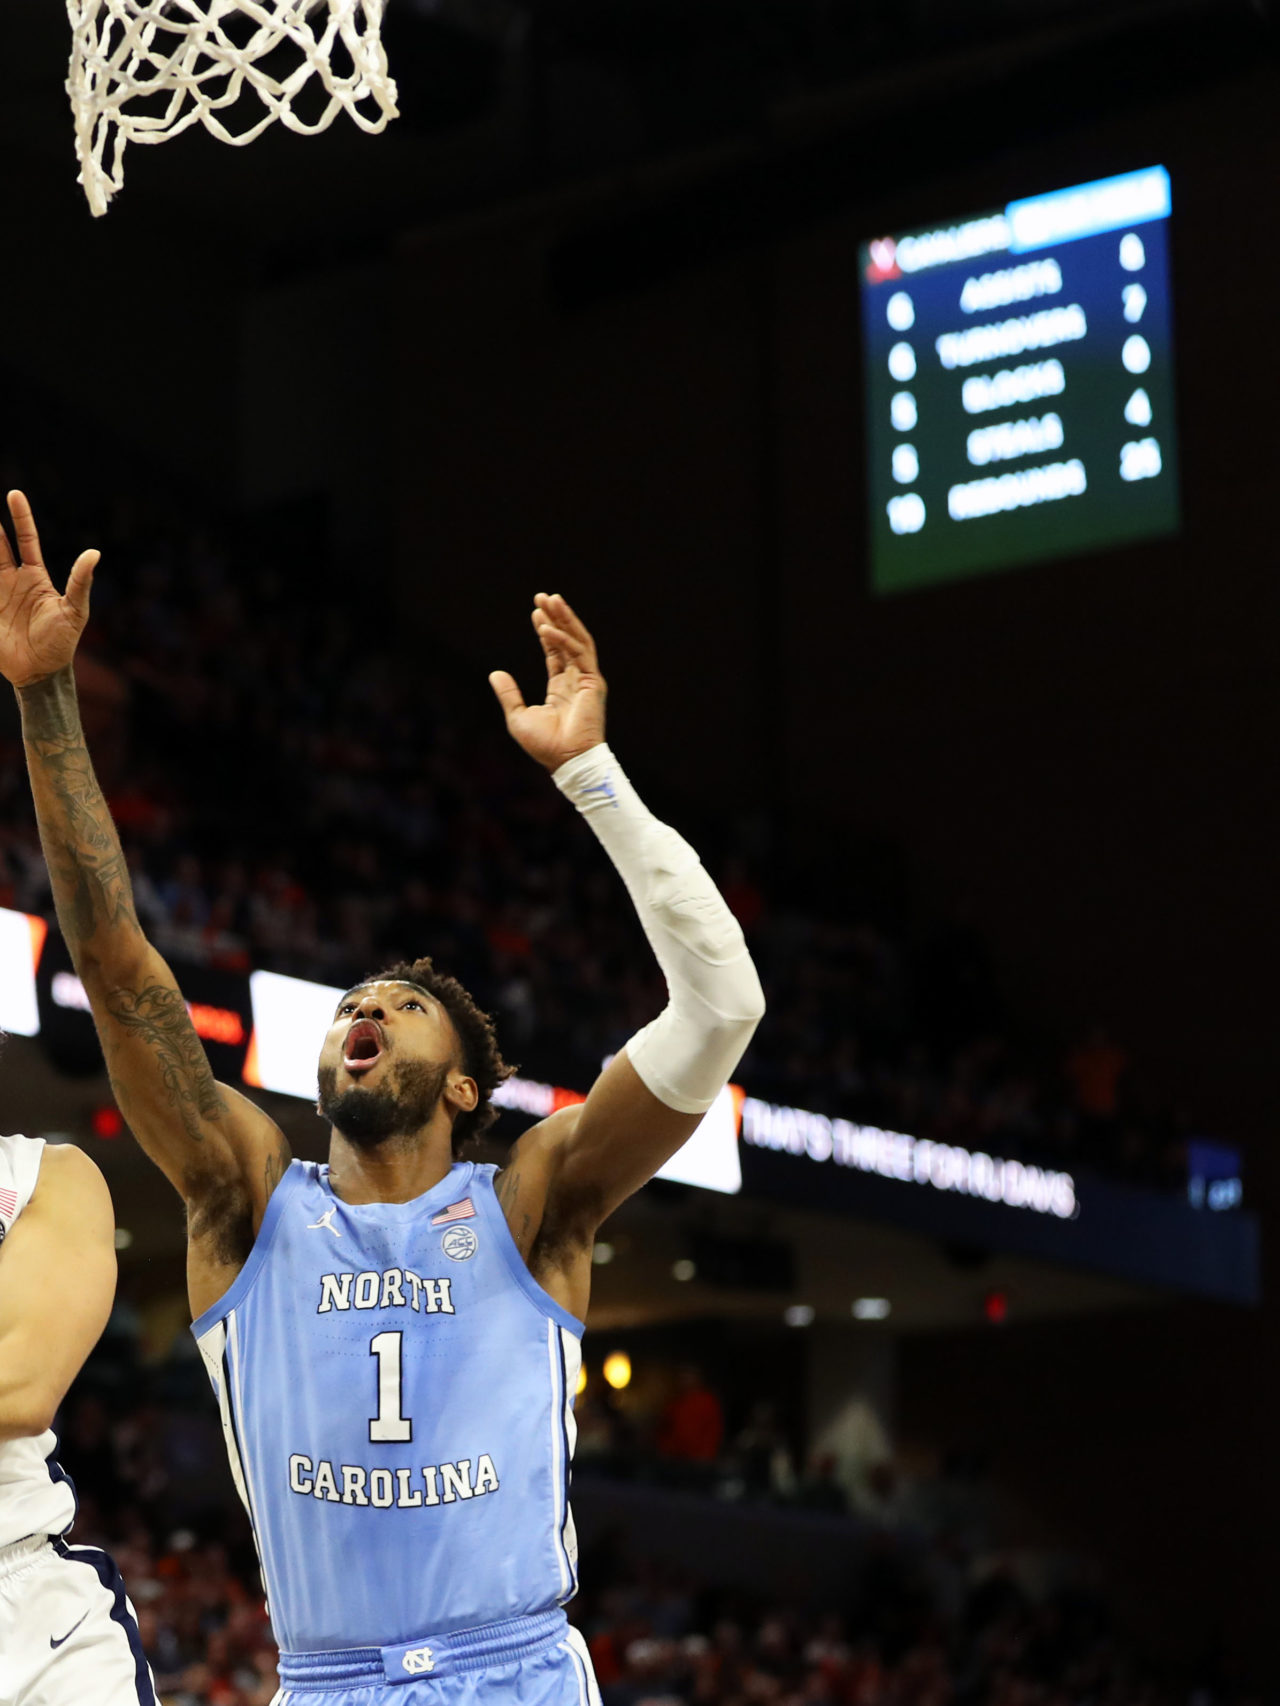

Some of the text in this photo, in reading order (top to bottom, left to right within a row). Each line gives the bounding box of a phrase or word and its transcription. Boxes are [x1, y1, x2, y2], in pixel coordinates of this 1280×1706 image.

[317, 1267, 456, 1314] NORTH
[368, 1330, 413, 1443] 1
[288, 1453, 500, 1508] CAROLINA
